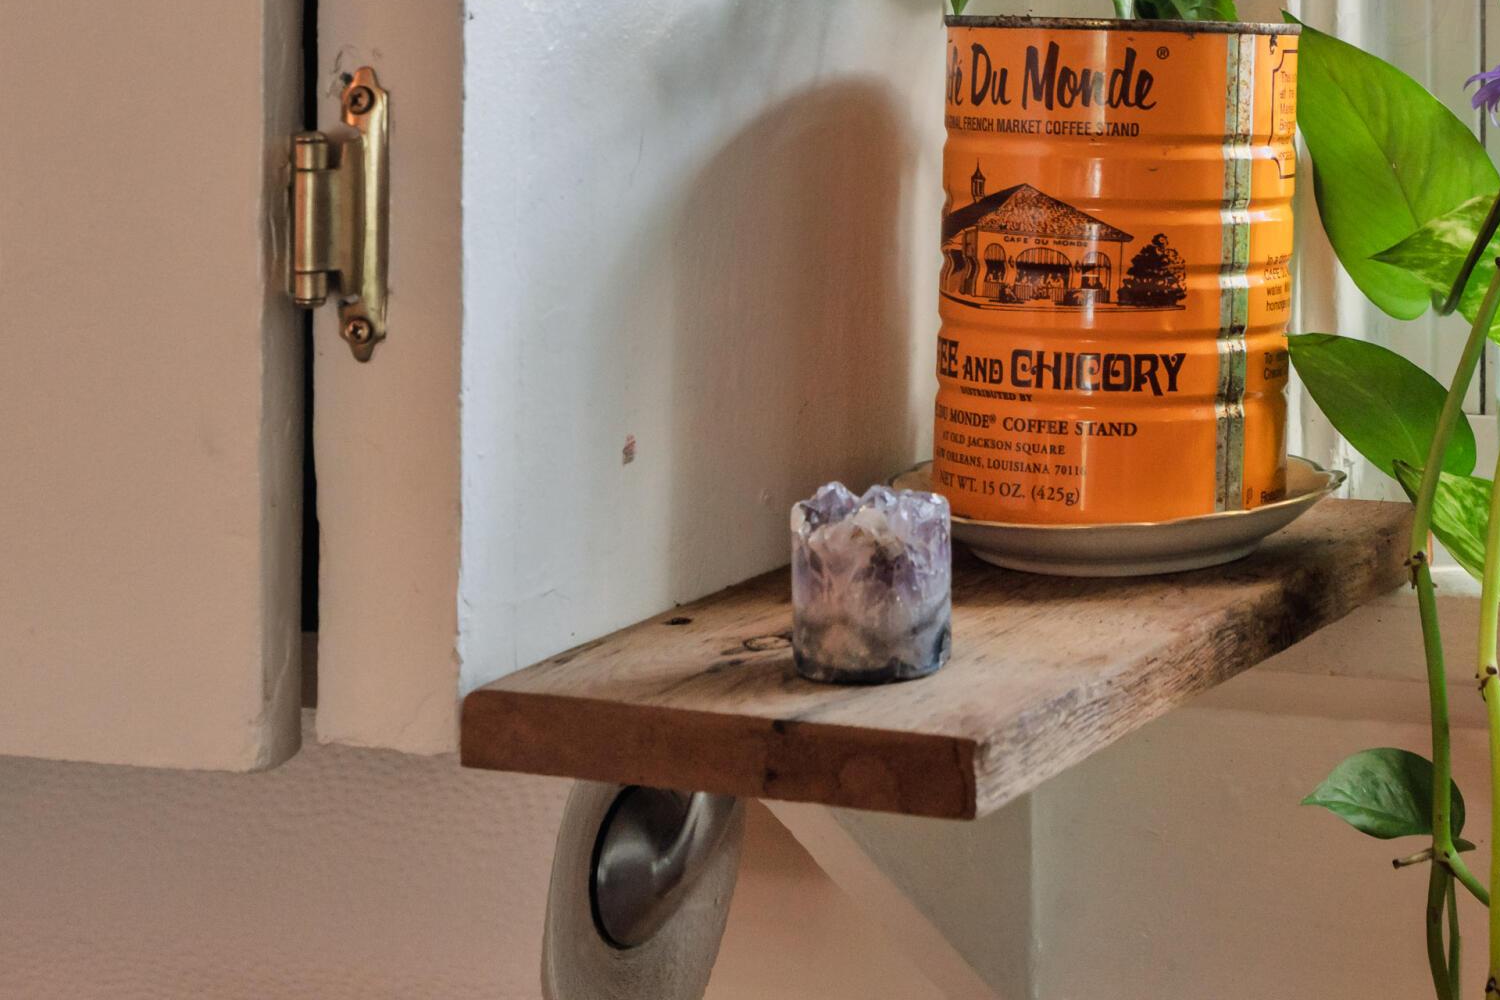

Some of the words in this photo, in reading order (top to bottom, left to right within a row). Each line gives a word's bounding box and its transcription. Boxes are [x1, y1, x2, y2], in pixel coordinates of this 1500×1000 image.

[971, 42, 1012, 106] Du
[963, 115, 994, 132] FRENCH
[996, 118, 1041, 135] MARKET
[1045, 120, 1092, 136] COFFEE
[1095, 121, 1140, 137] STAND
[937, 335, 960, 379] EE
[962, 355, 1004, 385] AND
[1010, 349, 1187, 396] CHICORY
[1019, 393, 1033, 402] BY
[1002, 416, 1069, 436] COFFEE
[1074, 421, 1138, 437] STAND
[967, 435, 1012, 451] JACKSON
[1015, 441, 1066, 456] SQUARE
[986, 457, 1050, 475] LOUISIANA
[982, 480, 996, 496] 15
[999, 482, 1026, 499] OZ.
[1031, 485, 1081, 506] (425g)
